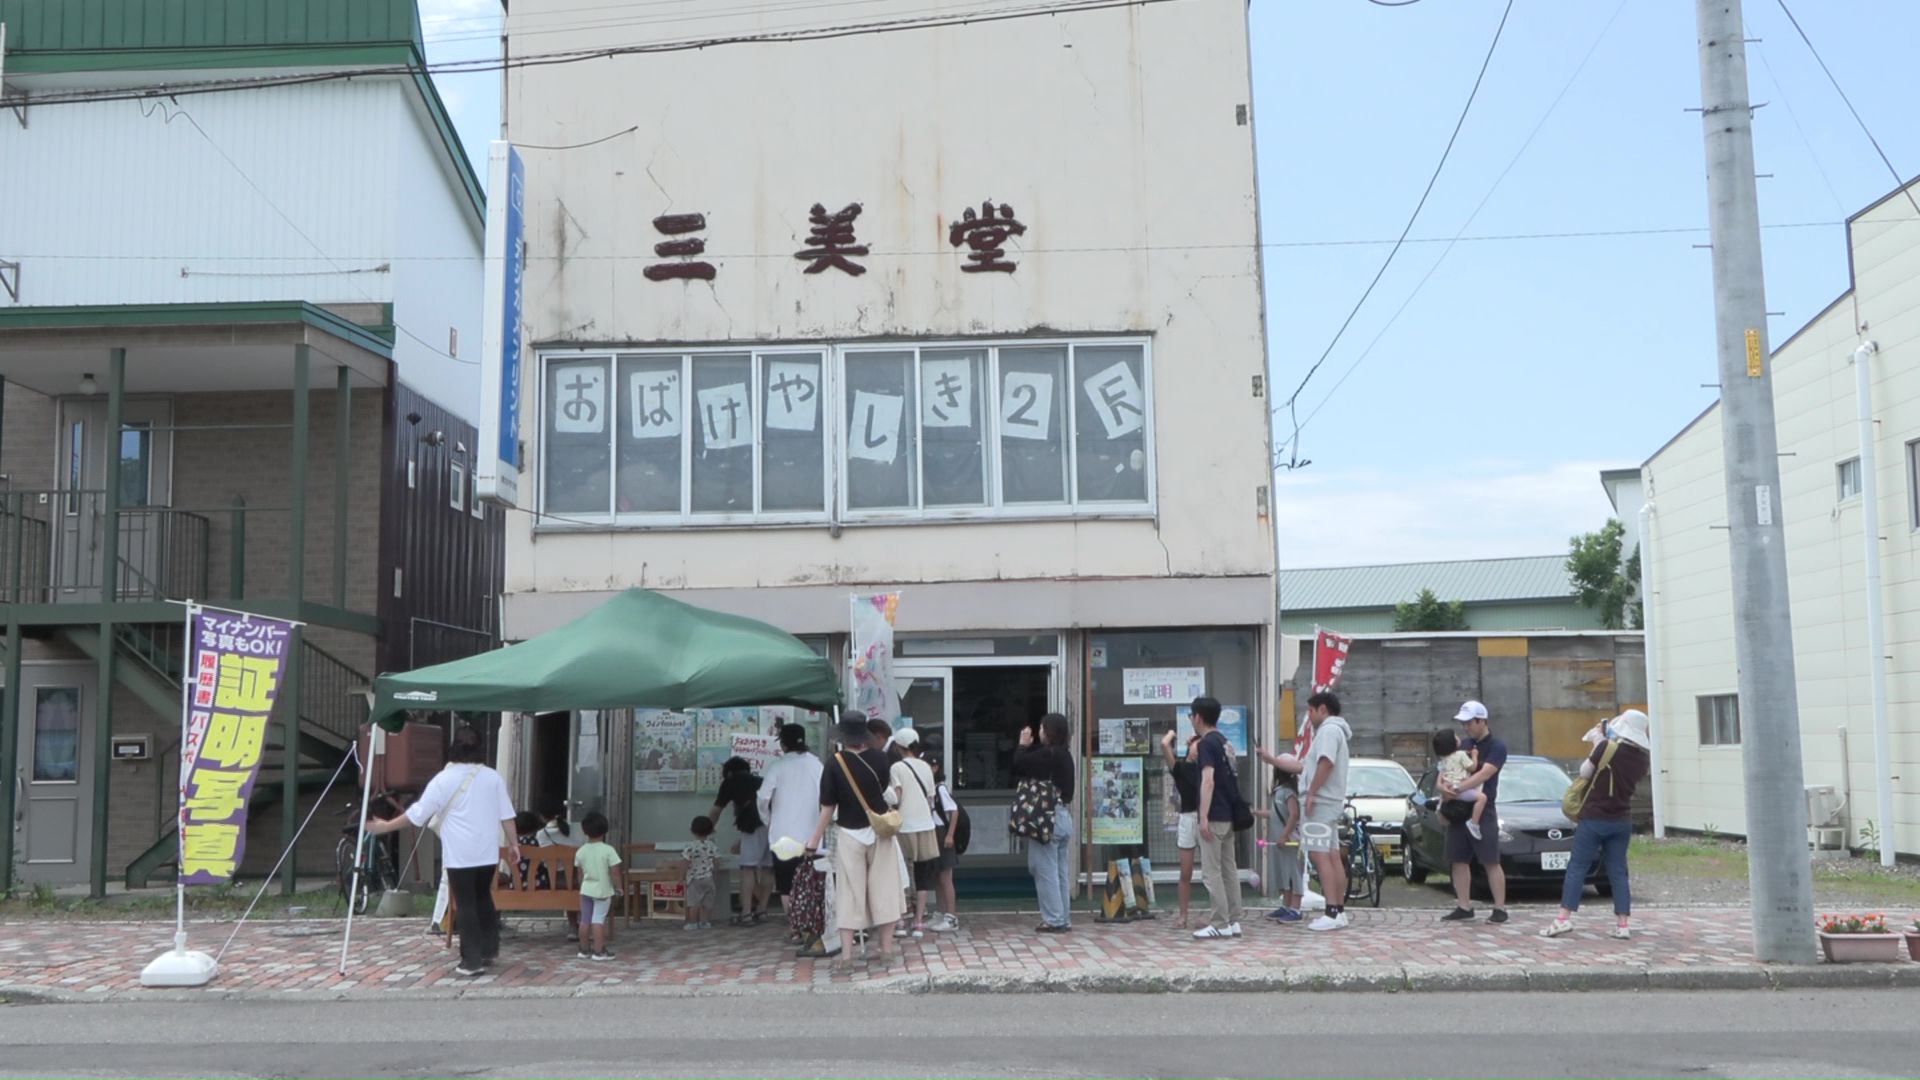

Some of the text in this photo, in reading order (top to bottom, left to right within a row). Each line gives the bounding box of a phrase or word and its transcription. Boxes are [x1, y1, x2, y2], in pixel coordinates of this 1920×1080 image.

[643, 200, 1026, 281] 三美堂
[201, 616, 288, 639] マイナンバー
[201, 630, 282, 655] 写真もOK!
[196, 653, 216, 705] 履歴書
[184, 653, 279, 877] 証明写真
